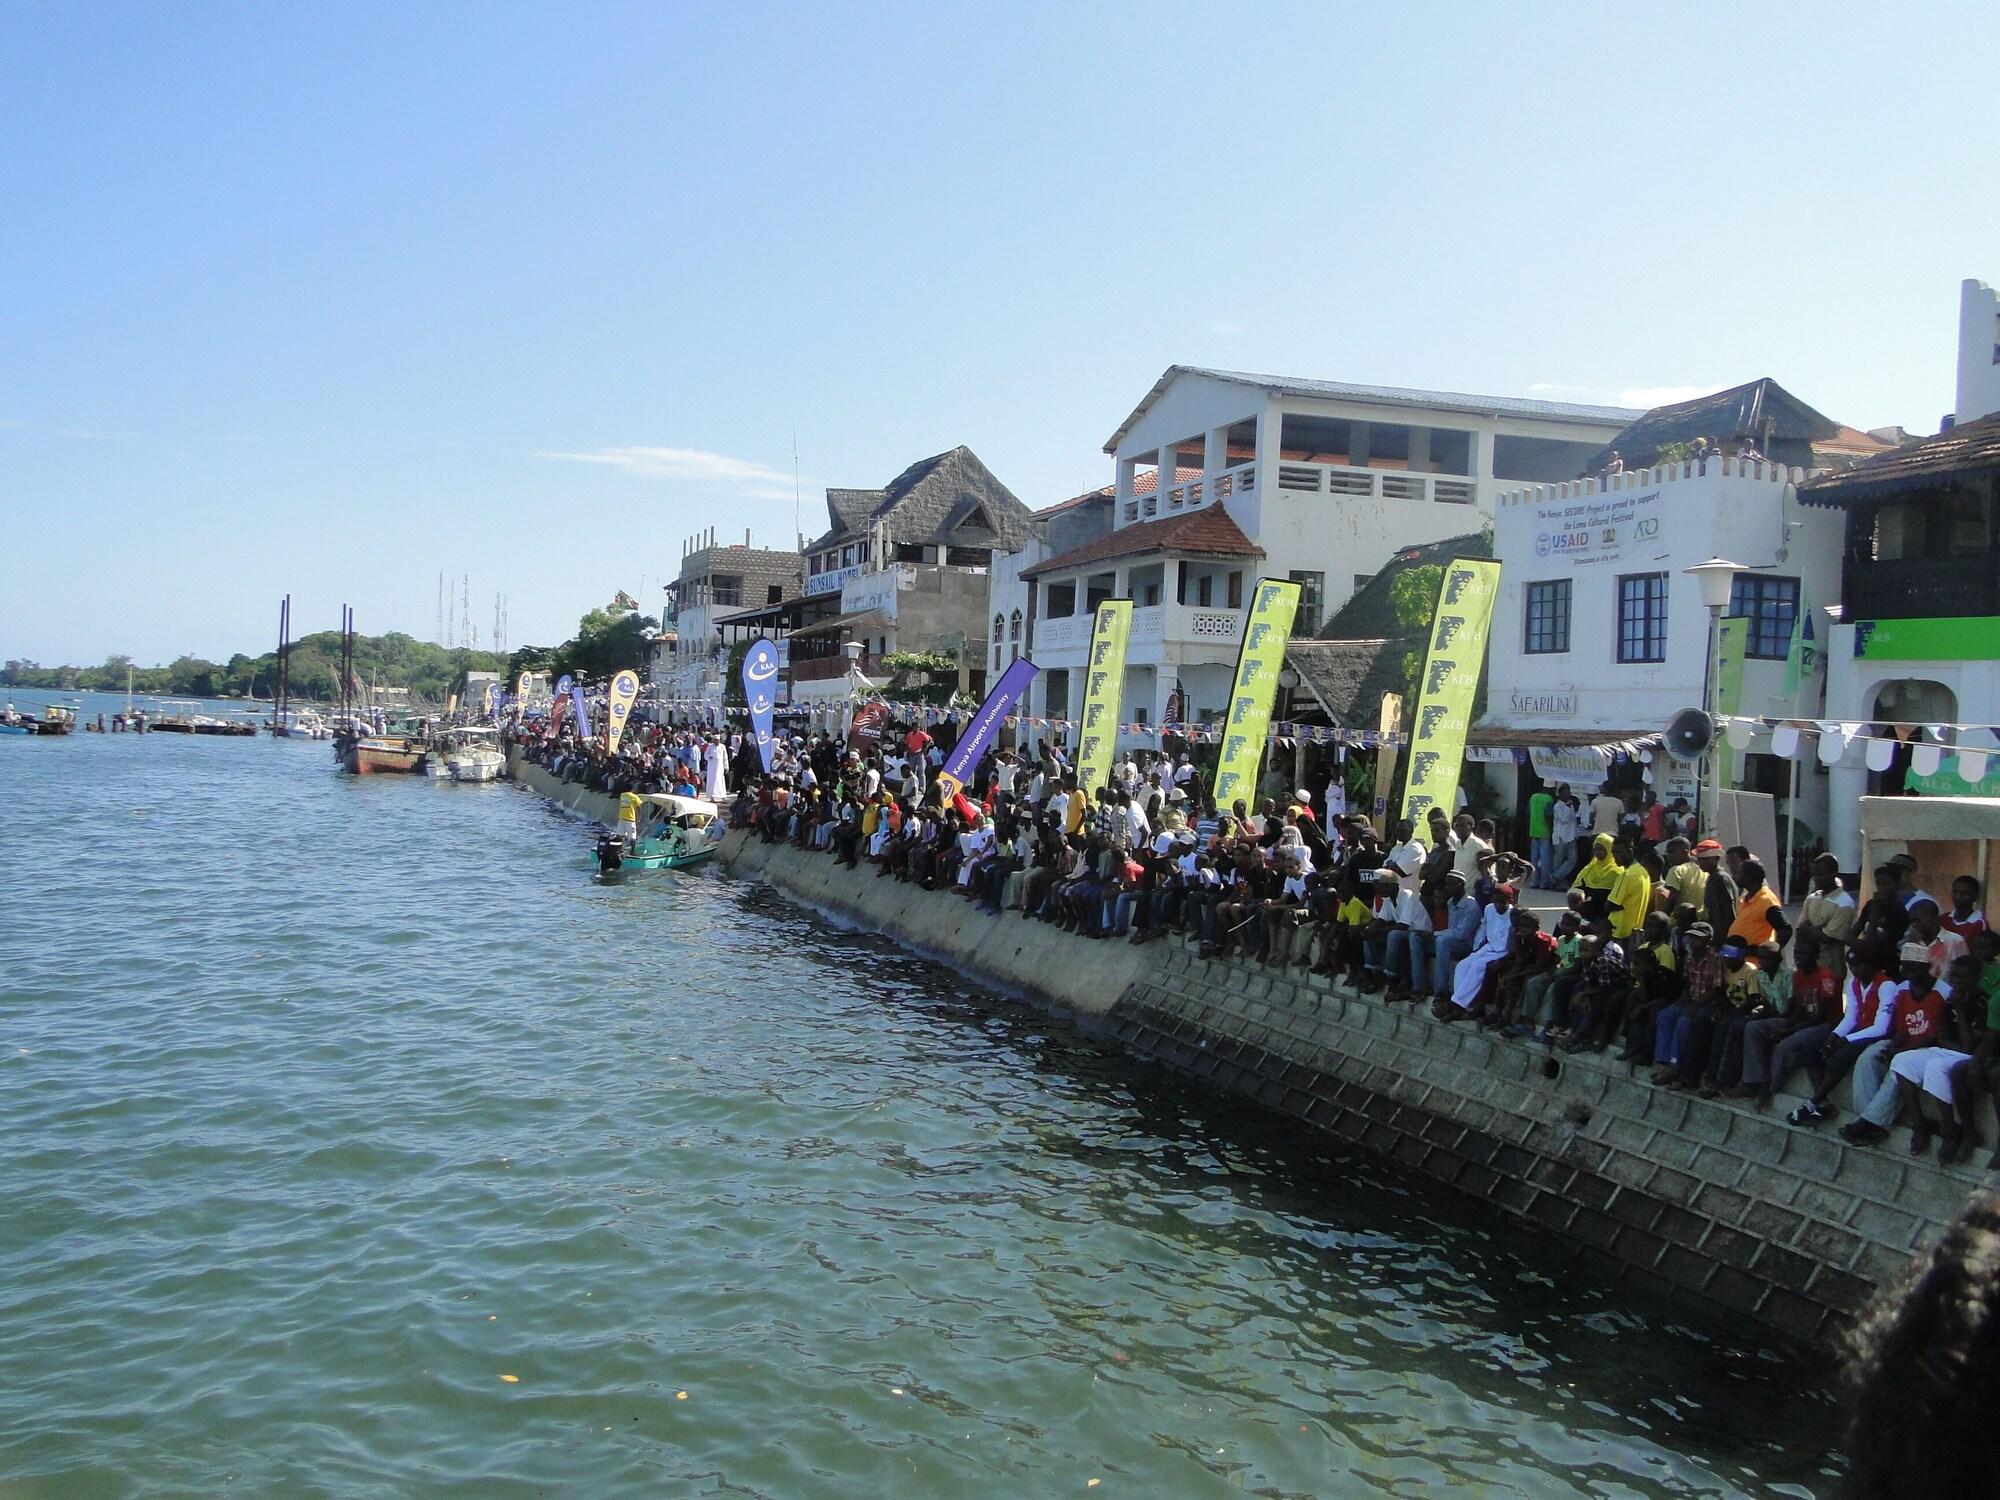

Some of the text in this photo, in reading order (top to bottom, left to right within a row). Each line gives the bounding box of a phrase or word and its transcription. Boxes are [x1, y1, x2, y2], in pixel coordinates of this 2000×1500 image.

[1612, 498, 1629, 511] proud
[1638, 491, 1660, 505] support
[1611, 510, 1634, 524] Festival
[1552, 532, 1589, 548] USAID
[808, 574, 835, 593] SUNSAIL
[1469, 585, 1490, 595] KCB
[1460, 630, 1481, 641] KCB
[760, 662, 775, 671] KAA
[1451, 674, 1473, 685] KCB
[1511, 694, 1572, 713] SAFARILINK
[1443, 718, 1464, 729] KCB
[952, 693, 1009, 776] Kenya Airports Authority
